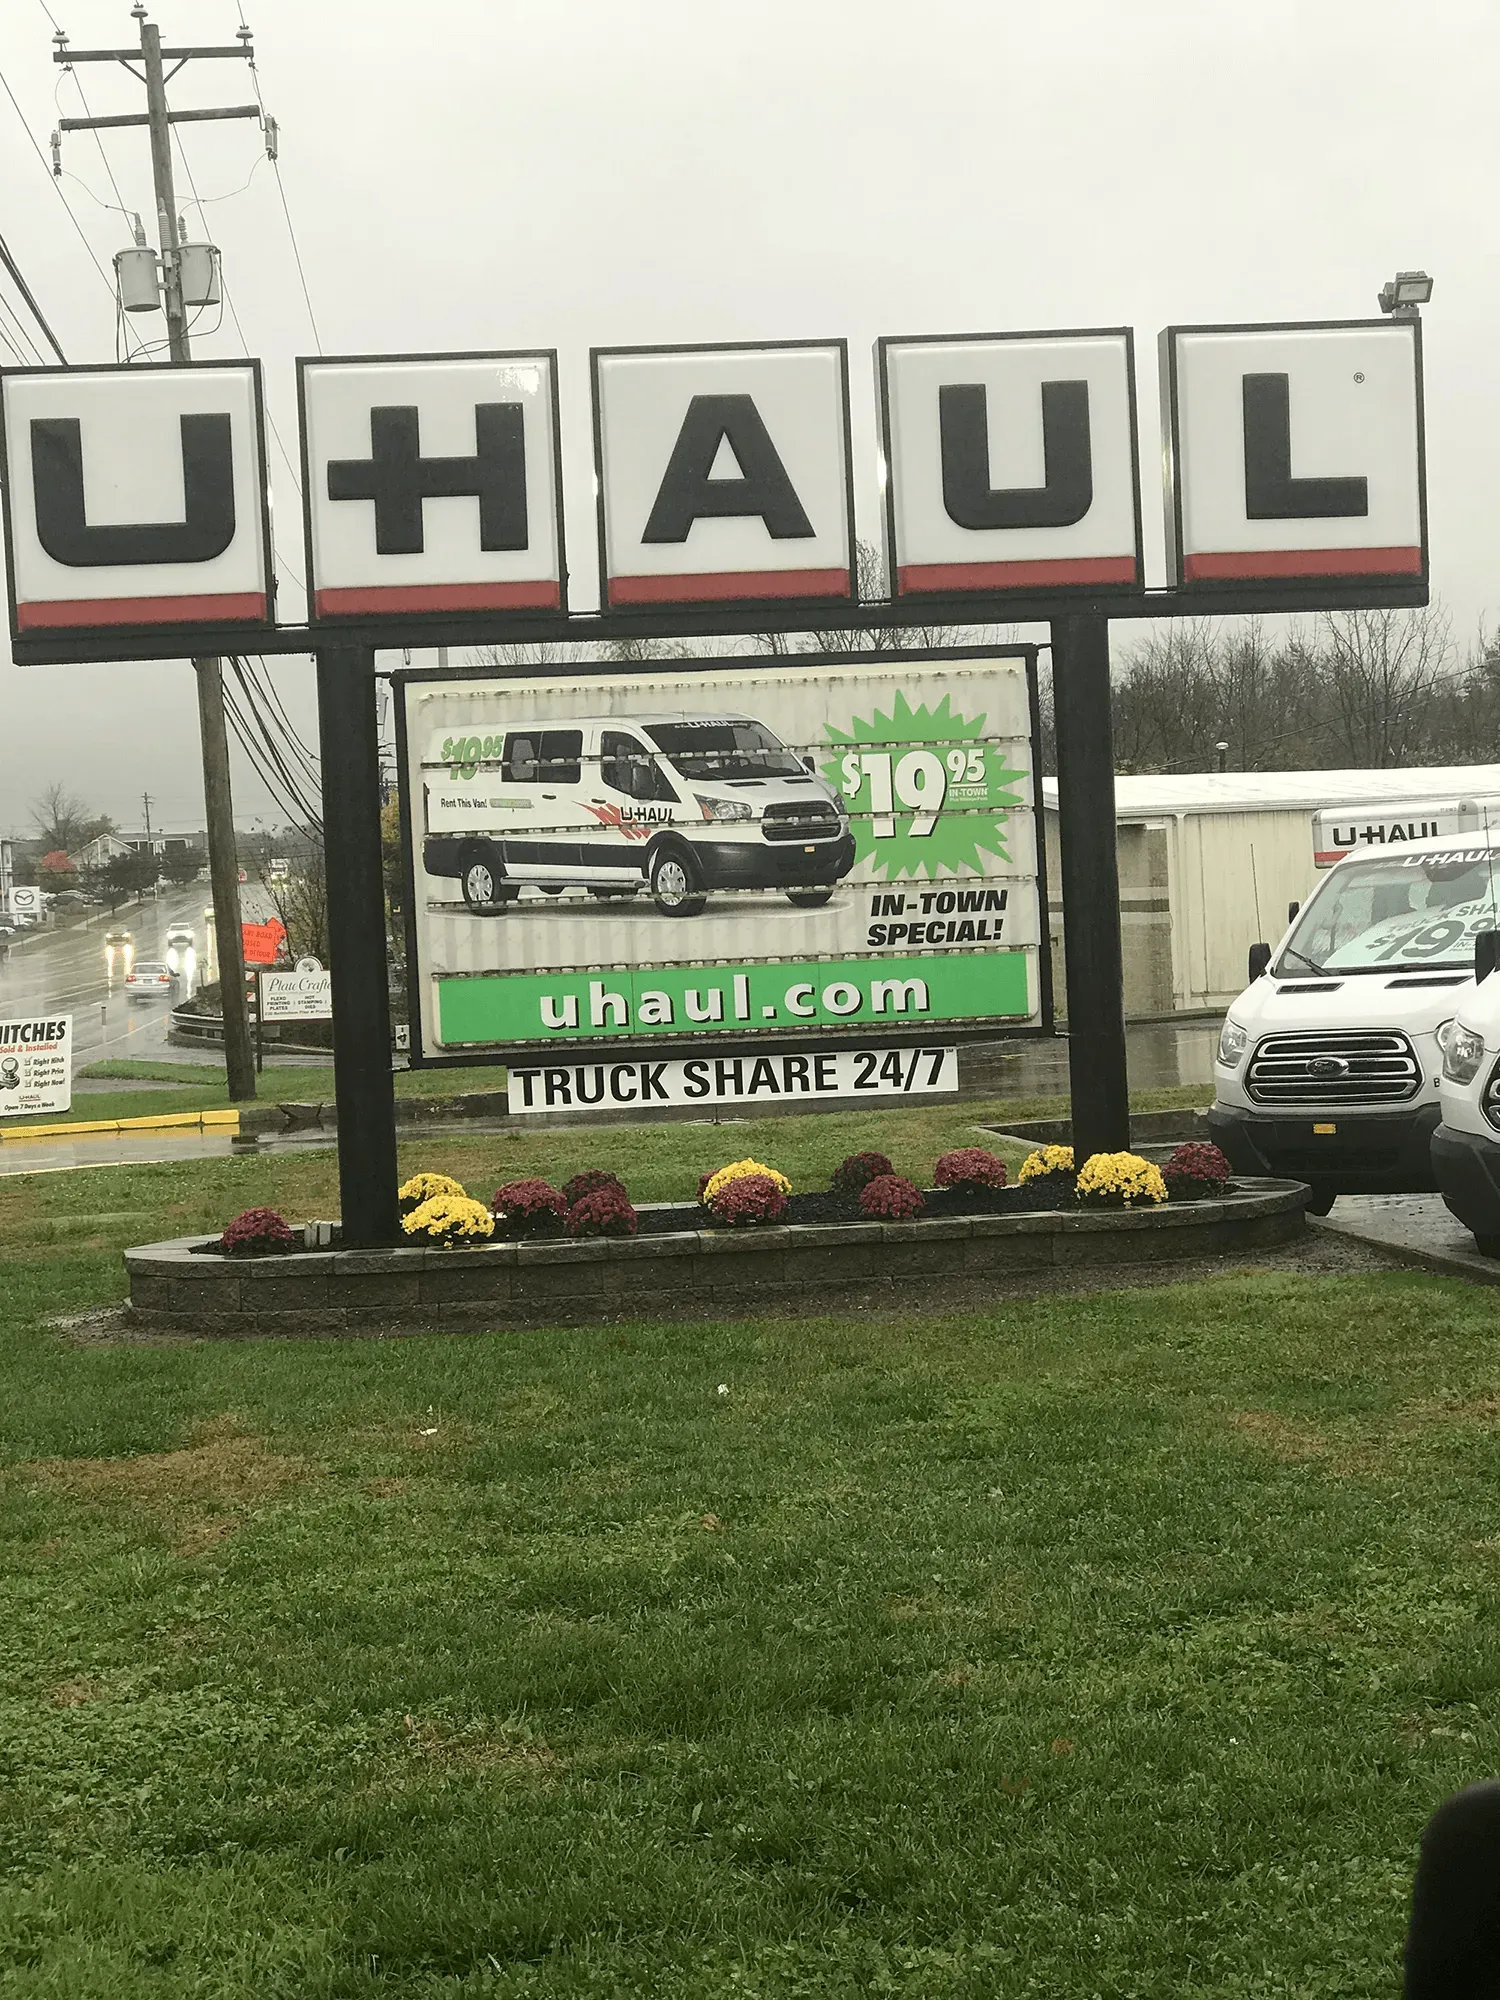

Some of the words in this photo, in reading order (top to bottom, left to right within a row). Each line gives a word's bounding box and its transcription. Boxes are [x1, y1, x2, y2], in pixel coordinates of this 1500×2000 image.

[949, 788, 988, 797] IN-TOWN
[440, 798, 456, 808] Rent
[457, 798, 472, 808] This
[473, 798, 488, 808] Van!
[620, 806, 674, 822] U-HAUL
[870, 889, 1008, 917] IN-TOWN
[866, 919, 1004, 947] SPECIAL!
[268, 977, 297, 992] Plate
[540, 973, 931, 1029] uhaul.com
[0, 1021, 66, 1044] ITCHES
[0, 1044, 15, 1054] Sold
[17, 1044, 23, 1053] &
[25, 1041, 58, 1052] Installed
[33, 1058, 49, 1067] Right
[33, 1069, 50, 1078] Right
[51, 1067, 64, 1075] Price
[513, 1062, 670, 1107] TRUCK
[682, 1055, 839, 1098] SHARE
[852, 1048, 947, 1090] 24/7
[33, 1080, 50, 1089] Right
